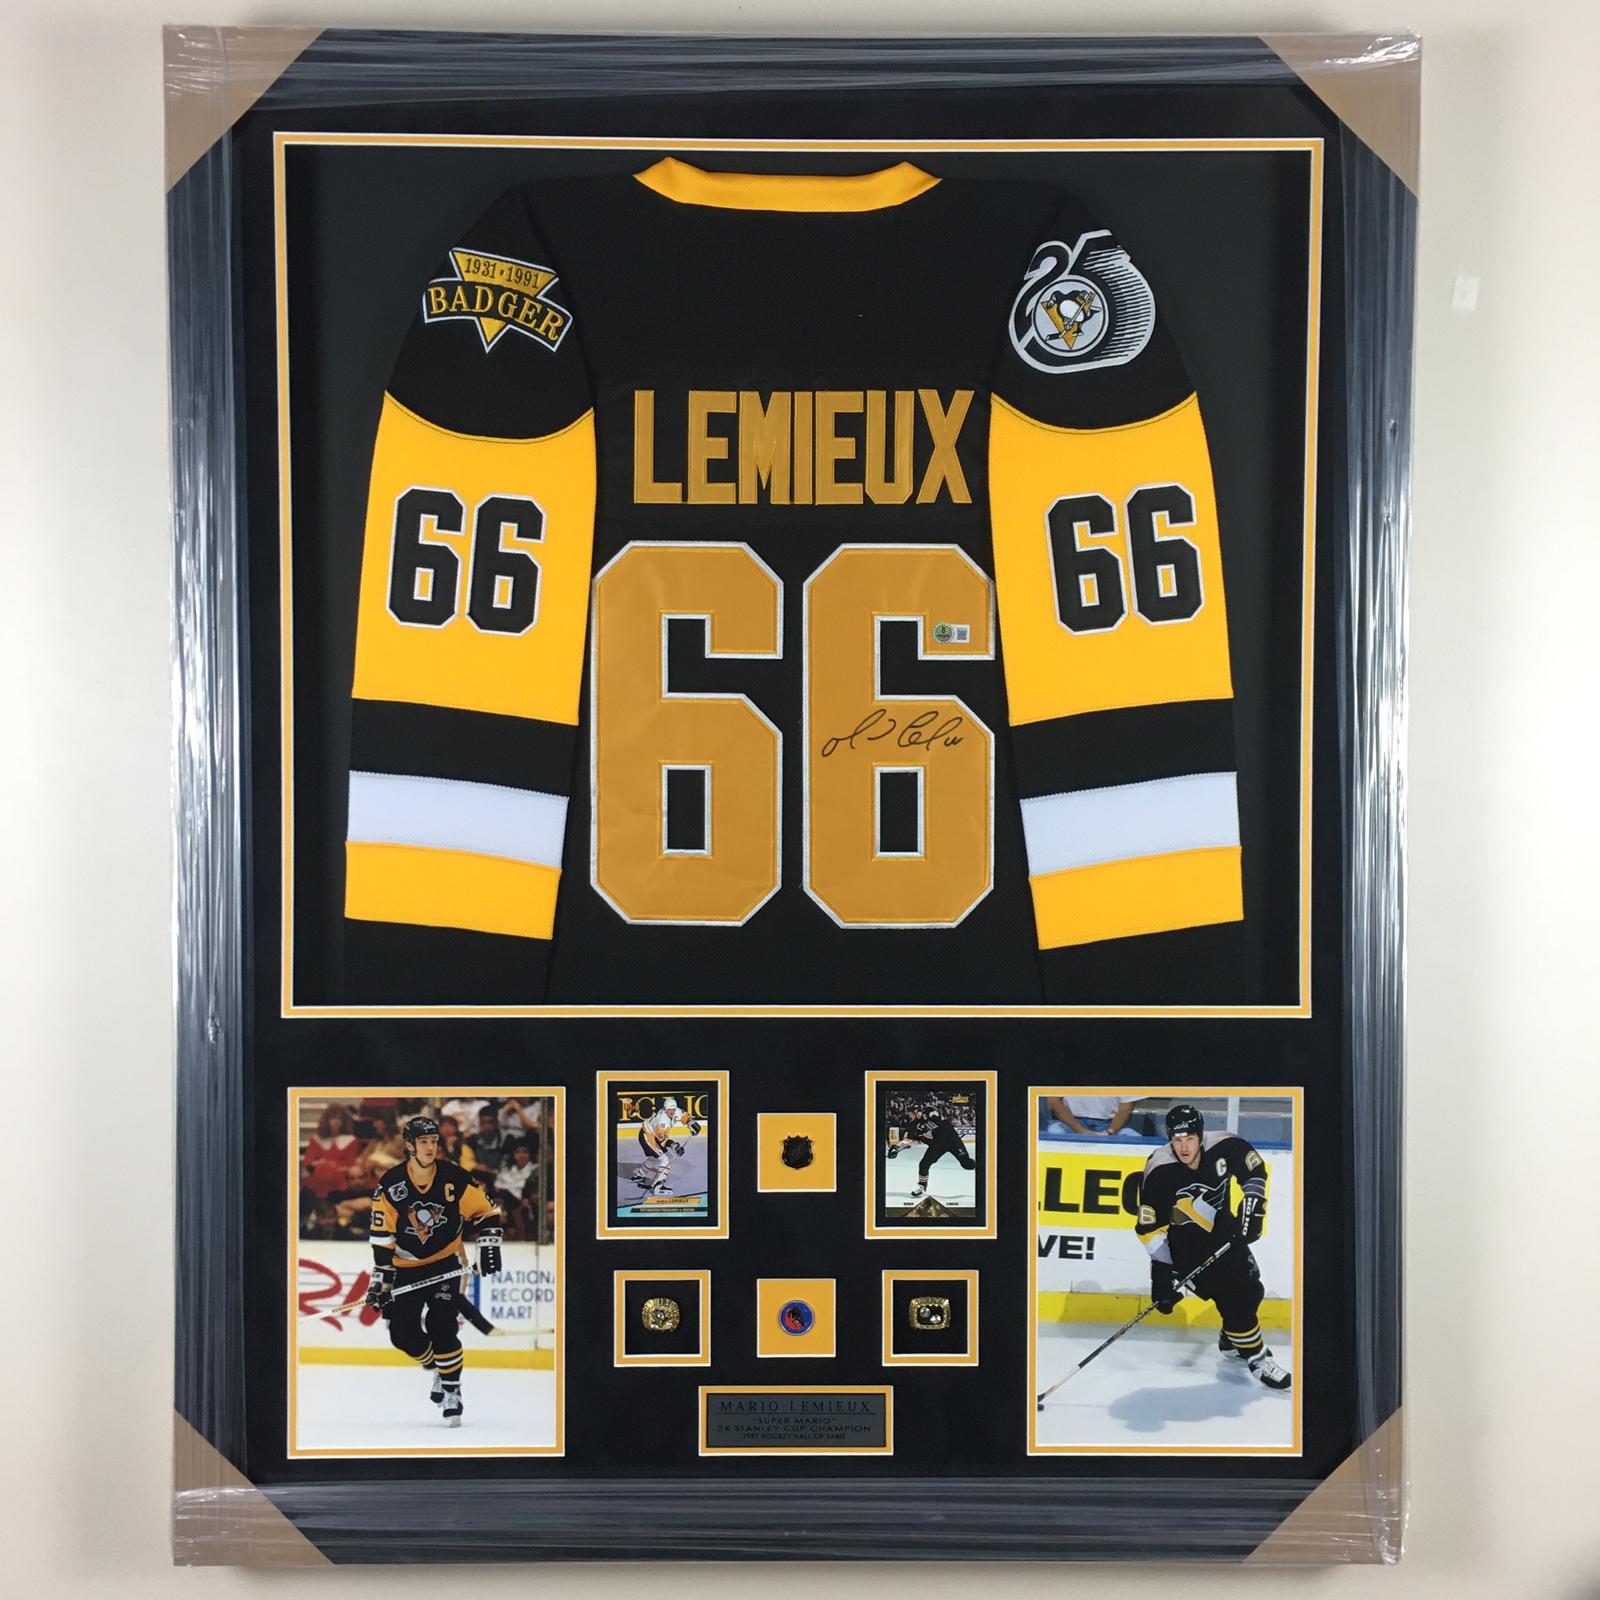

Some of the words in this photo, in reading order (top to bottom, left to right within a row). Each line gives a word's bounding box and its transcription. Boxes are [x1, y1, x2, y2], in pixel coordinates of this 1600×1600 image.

[428, 285, 564, 341] BADGER
[634, 389, 975, 505] LEMIEUX
[386, 485, 547, 637] 66
[1044, 482, 1205, 636] 66
[590, 541, 995, 929] 66
[1215, 1158, 1228, 1177] C
[444, 1182, 456, 1202] C
[491, 1270, 554, 1284] NATION
[491, 1287, 554, 1302] RECORD
[491, 1305, 532, 1319] MART
[720, 1401, 778, 1412] MARIO
[790, 1401, 871, 1412] LEMIEUX
